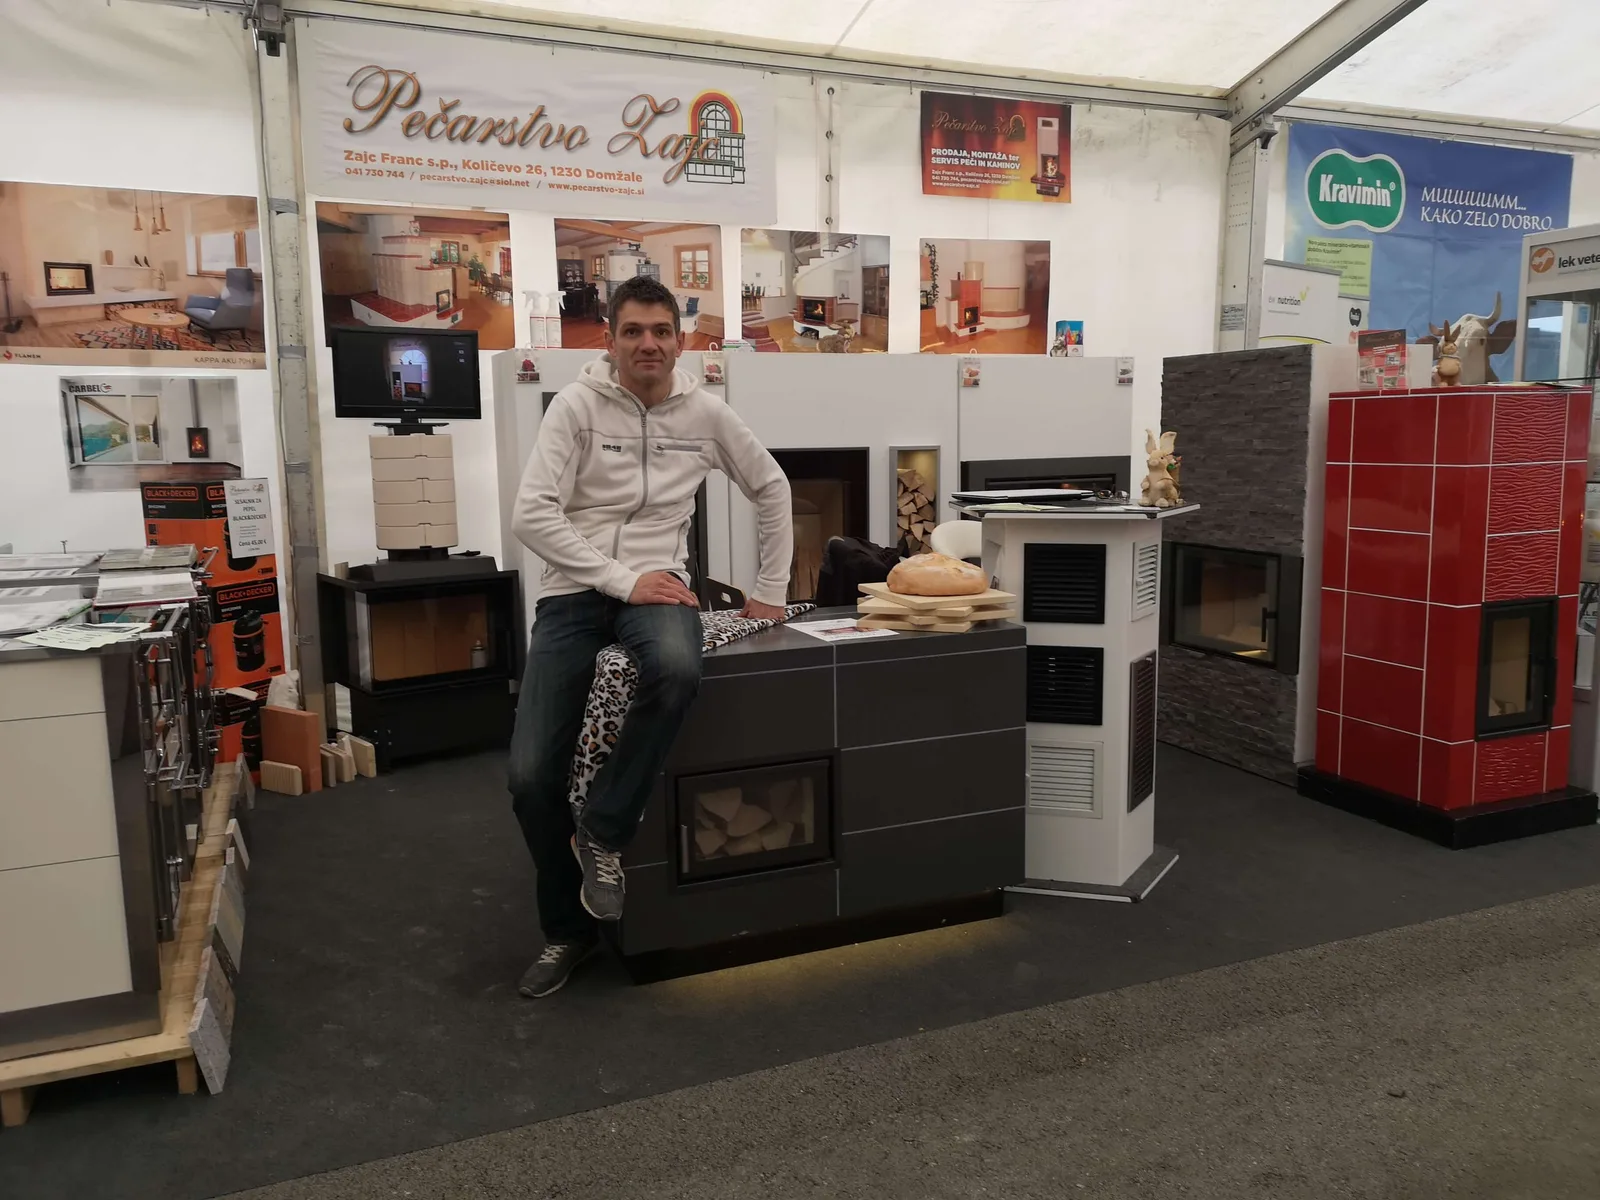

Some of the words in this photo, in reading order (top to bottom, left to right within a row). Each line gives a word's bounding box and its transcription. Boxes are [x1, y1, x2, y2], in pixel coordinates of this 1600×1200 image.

[343, 64, 590, 151] Pečarstvo
[607, 93, 719, 185] Zajc
[931, 148, 970, 158] PRODAJA,
[971, 150, 1007, 160] MONTAŽA
[931, 157, 959, 165] SERVIS
[960, 158, 977, 166] PEČI
[978, 159, 986, 167] IN
[986, 160, 1020, 169] KAMINOV
[344, 150, 376, 164] Zajc
[381, 152, 423, 166] Franc
[427, 158, 458, 171] s.p.,
[462, 159, 521, 173] Količevo
[526, 164, 547, 177] 26,
[550, 166, 582, 178] 1230
[586, 168, 642, 182] Domžale
[345, 167, 363, 175] 041
[365, 168, 384, 177] 730
[386, 170, 405, 178] 744
[420, 173, 529, 187] pecarstvo.zajc@siol.net
[548, 182, 645, 195] www.pecarstvo-zajc.si
[1421, 206, 1462, 224] KAKO
[1464, 210, 1499, 228] ZELO
[1558, 255, 1576, 269] lek
[220, 586, 272, 600] BLACK+DECKER
